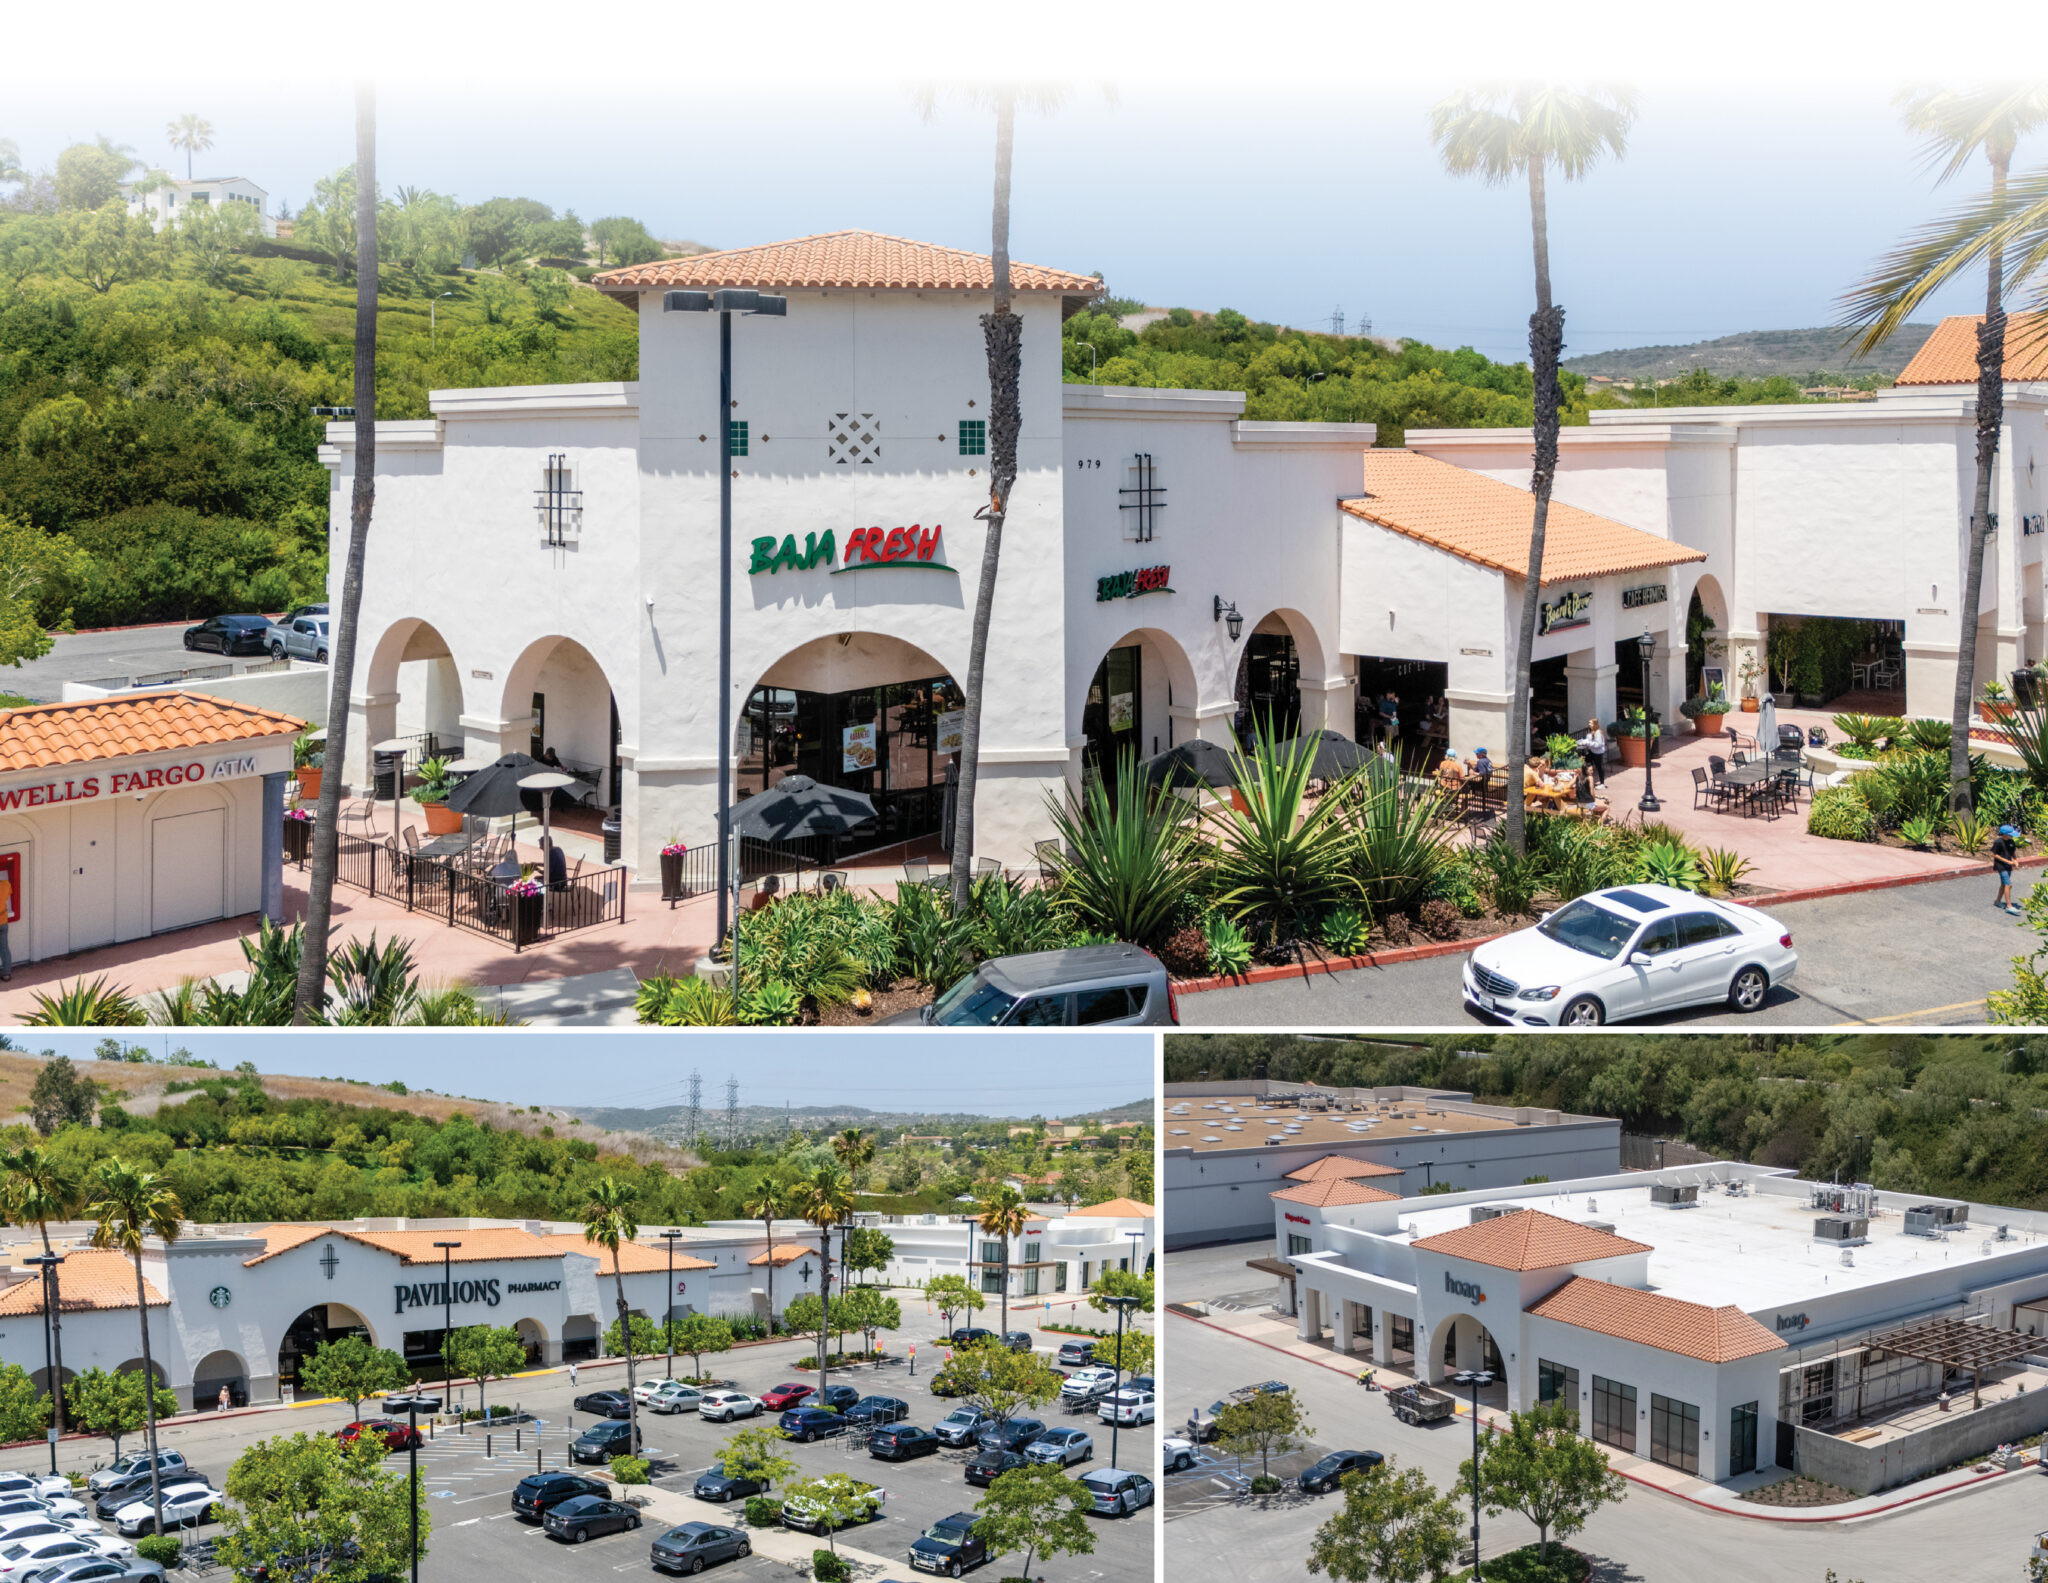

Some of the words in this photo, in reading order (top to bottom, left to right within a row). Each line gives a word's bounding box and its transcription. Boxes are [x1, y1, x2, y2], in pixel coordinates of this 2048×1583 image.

[1078, 459, 1101, 470] 979
[748, 528, 836, 575] BAJA
[843, 524, 942, 563] FRESH
[1097, 571, 1134, 602] BAJA
[1135, 565, 1170, 592] FRESH
[0, 777, 99, 812] WELLS
[111, 763, 205, 794] FARGO
[211, 757, 257, 779] ATM
[394, 1278, 501, 1314] PAVILIONS
[508, 1281, 561, 1293] PHARMACY
